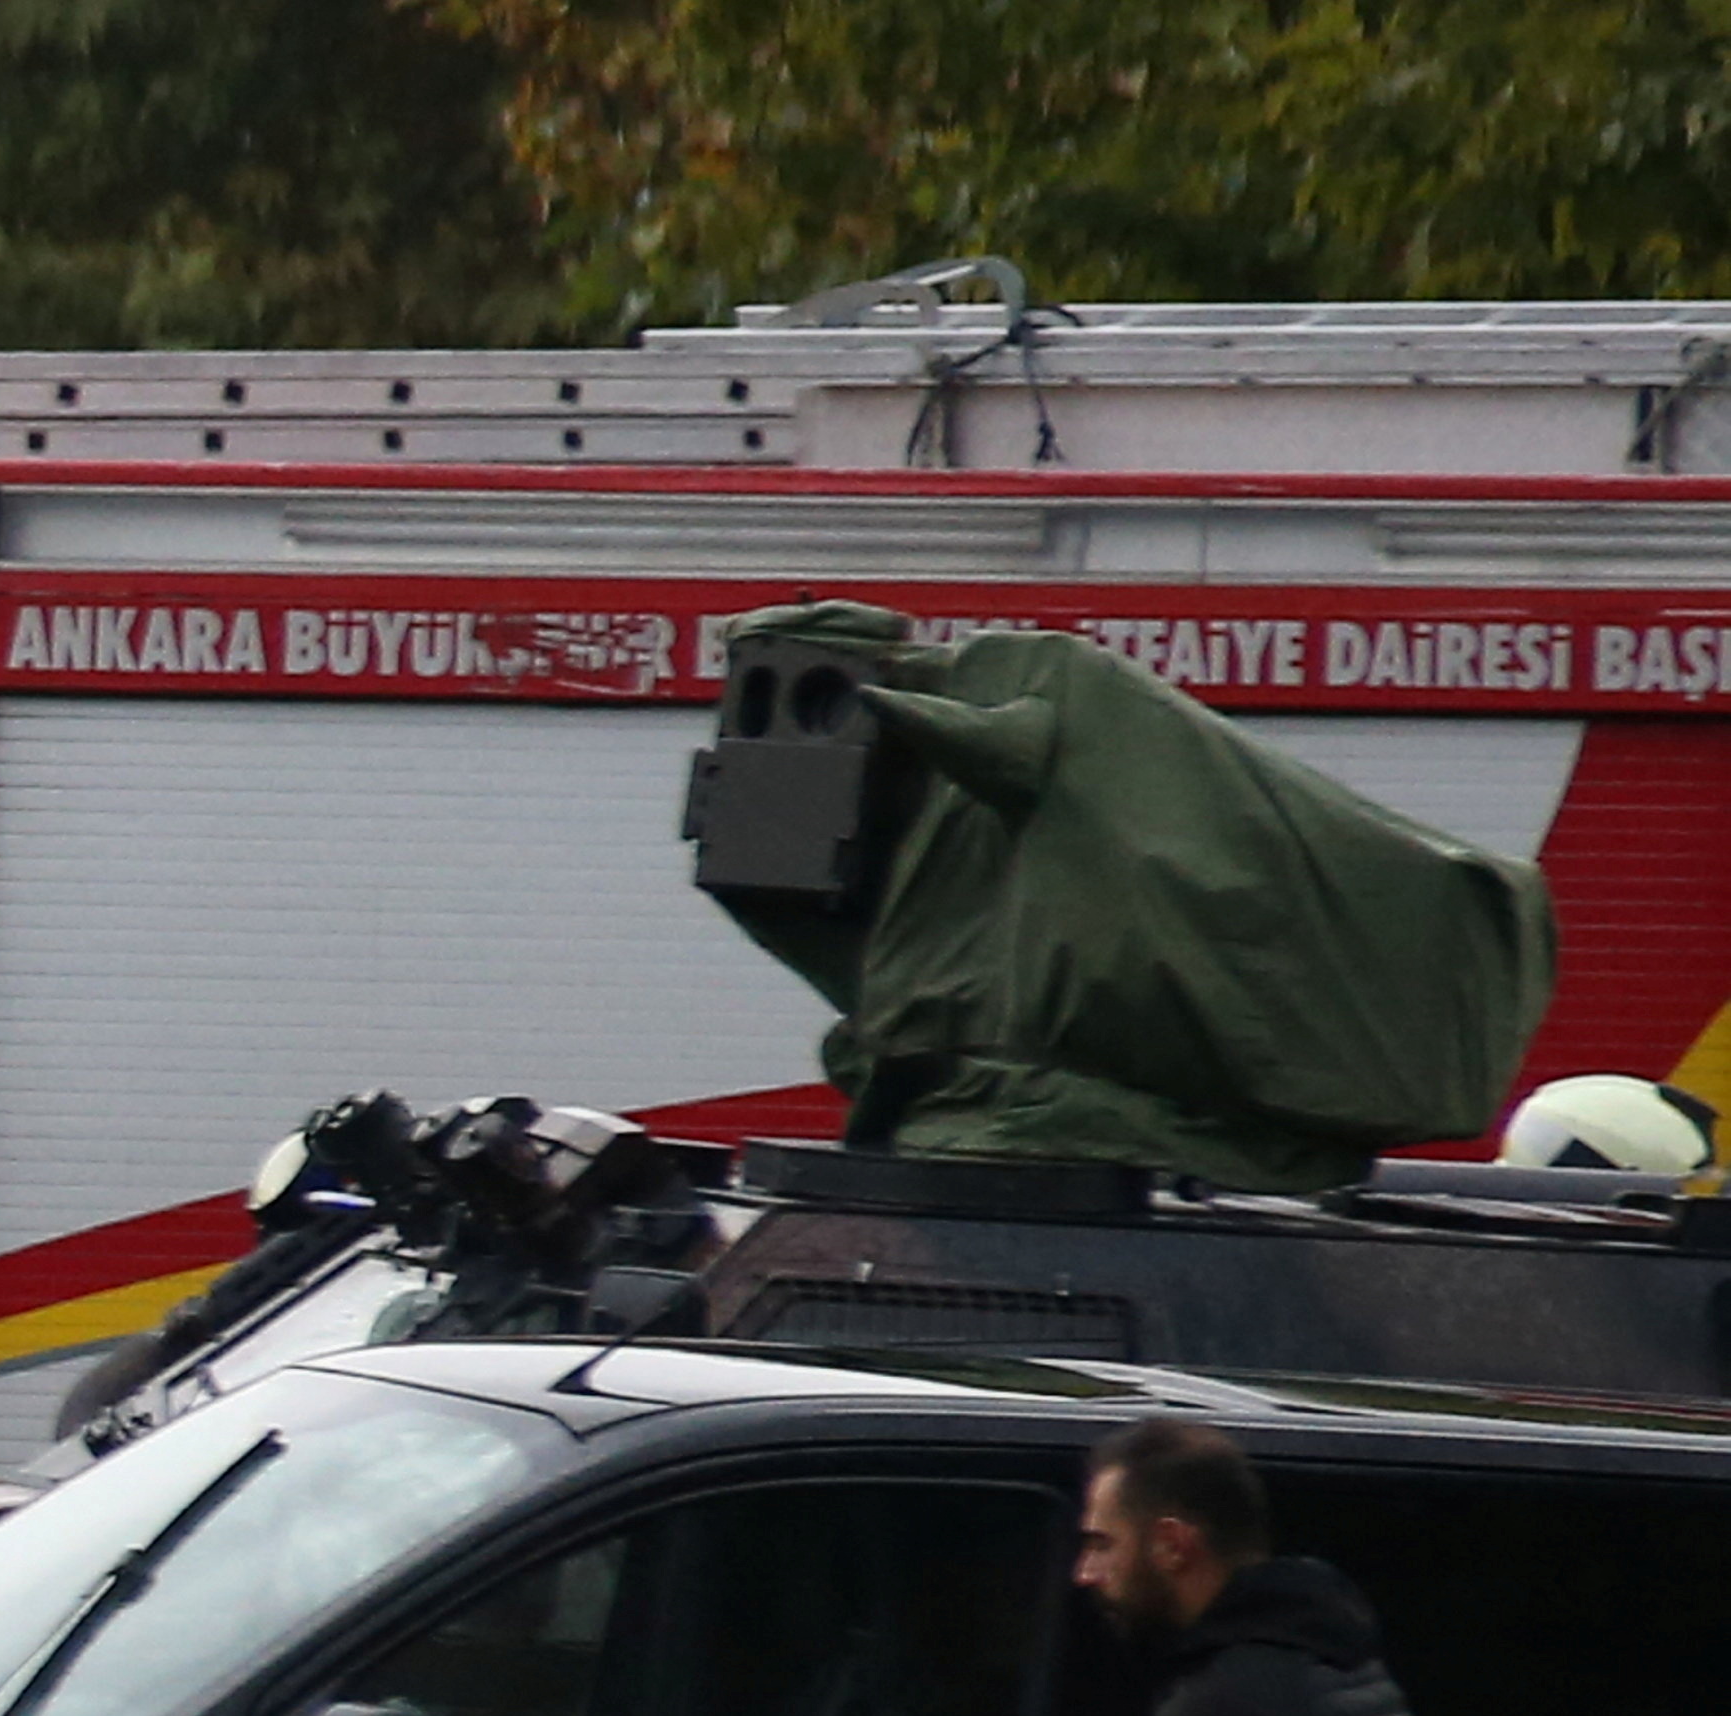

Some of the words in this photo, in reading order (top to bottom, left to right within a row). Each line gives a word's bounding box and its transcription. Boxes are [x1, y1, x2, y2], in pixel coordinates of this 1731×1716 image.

[6, 605, 267, 673] ANKARA
[1075, 617, 1307, 686] TFAİYE
[1324, 621, 1574, 691] DAİRESİ
[1592, 624, 1731, 702] BAŞ
